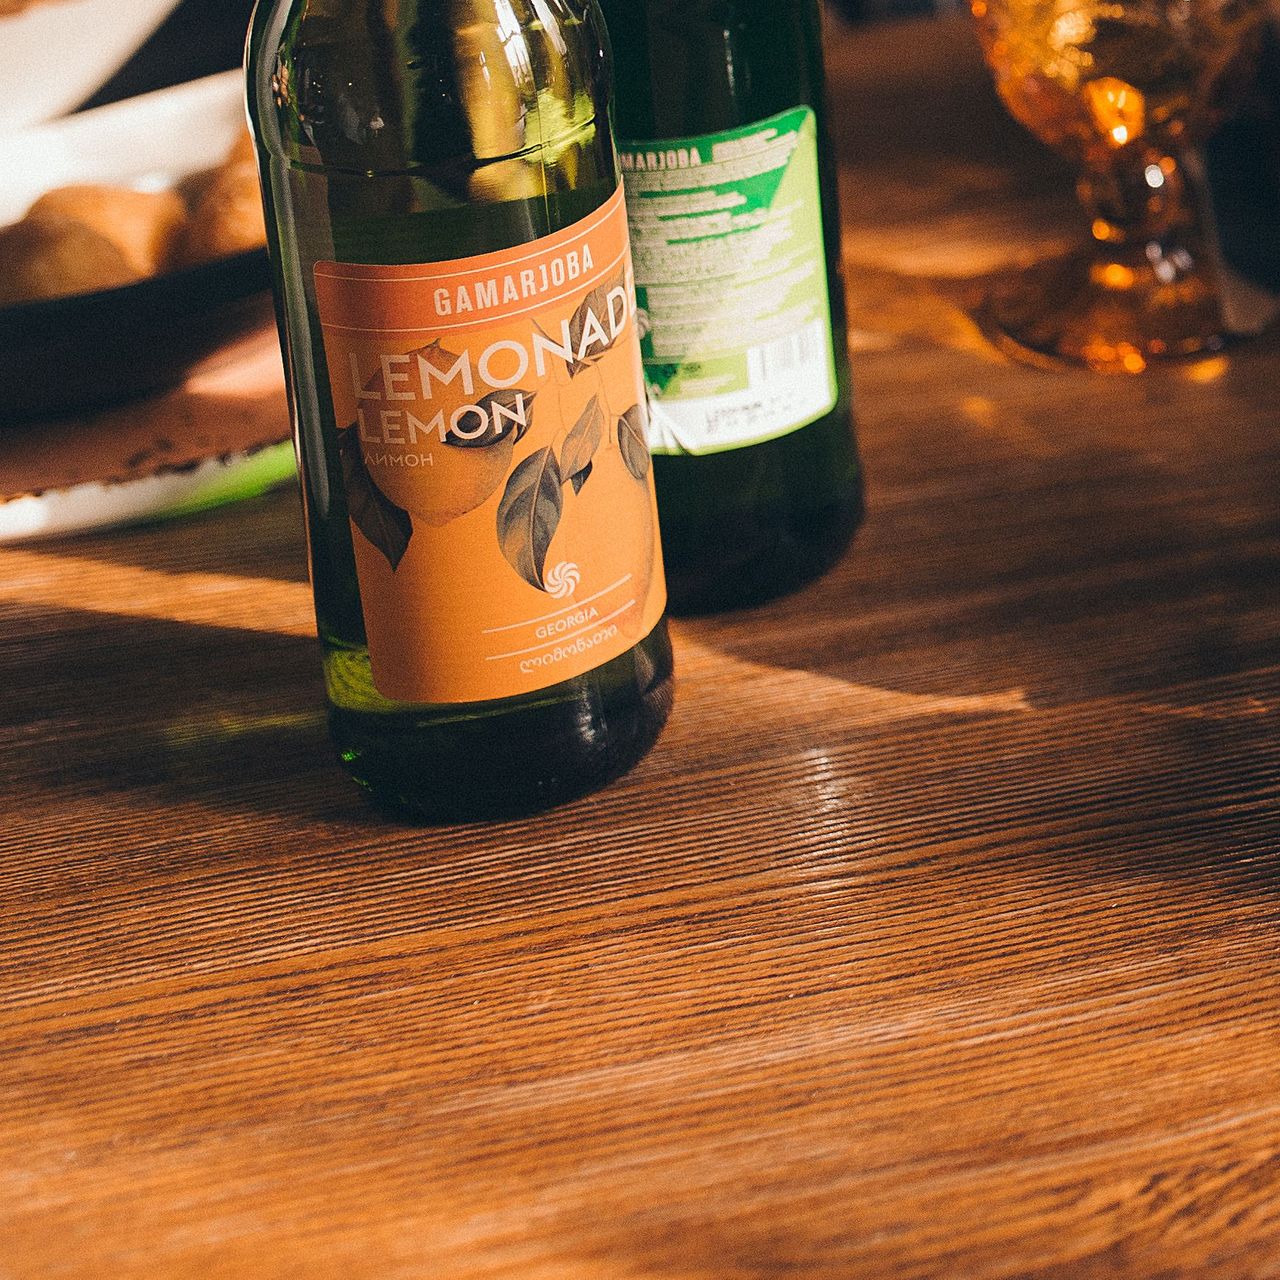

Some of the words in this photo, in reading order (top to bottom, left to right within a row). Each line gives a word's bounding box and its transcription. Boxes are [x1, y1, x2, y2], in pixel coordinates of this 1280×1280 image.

[617, 146, 702, 171] MARJOBA
[434, 244, 595, 317] GAMARJOBA
[357, 392, 528, 445] LEMON
[364, 452, 434, 468] ЛИМОН
[535, 606, 599, 638] GEORGIA
